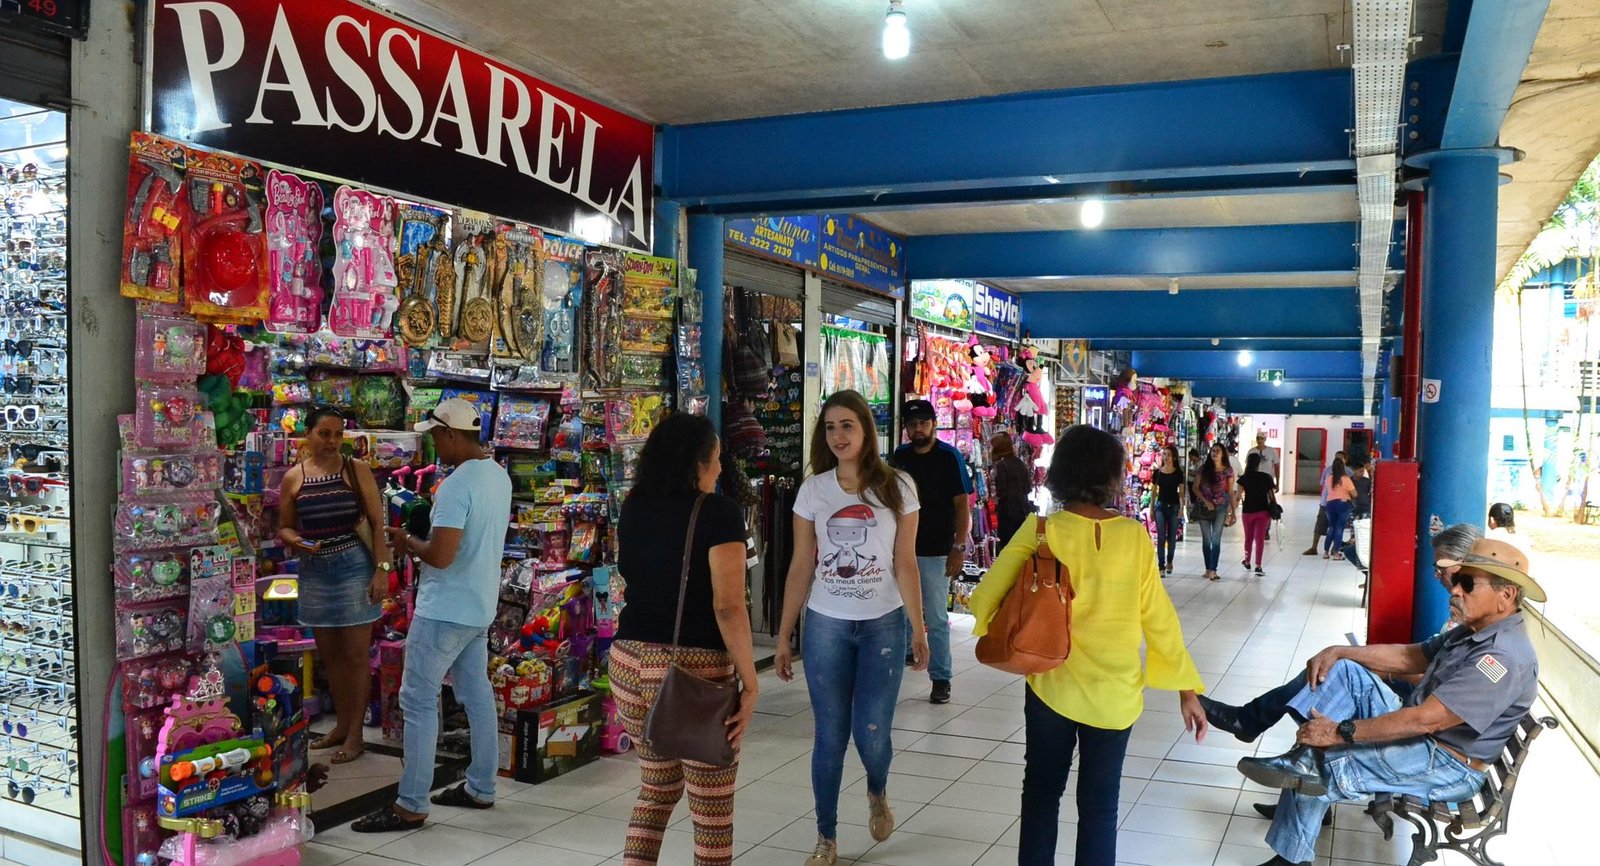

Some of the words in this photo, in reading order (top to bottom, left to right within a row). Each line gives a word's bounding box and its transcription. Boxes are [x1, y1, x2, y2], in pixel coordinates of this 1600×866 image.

[164, 1, 646, 246] PASSARELA
[728, 228, 747, 243] TEL:
[749, 236, 771, 251] 3222
[773, 244, 792, 258] 2139
[754, 225, 795, 248] ARTESANATO
[543, 240, 584, 260] POLICE
[975, 283, 1019, 325] Sheyla
[857, 577, 883, 585] clientes
[183, 792, 213, 807] STRIKE
